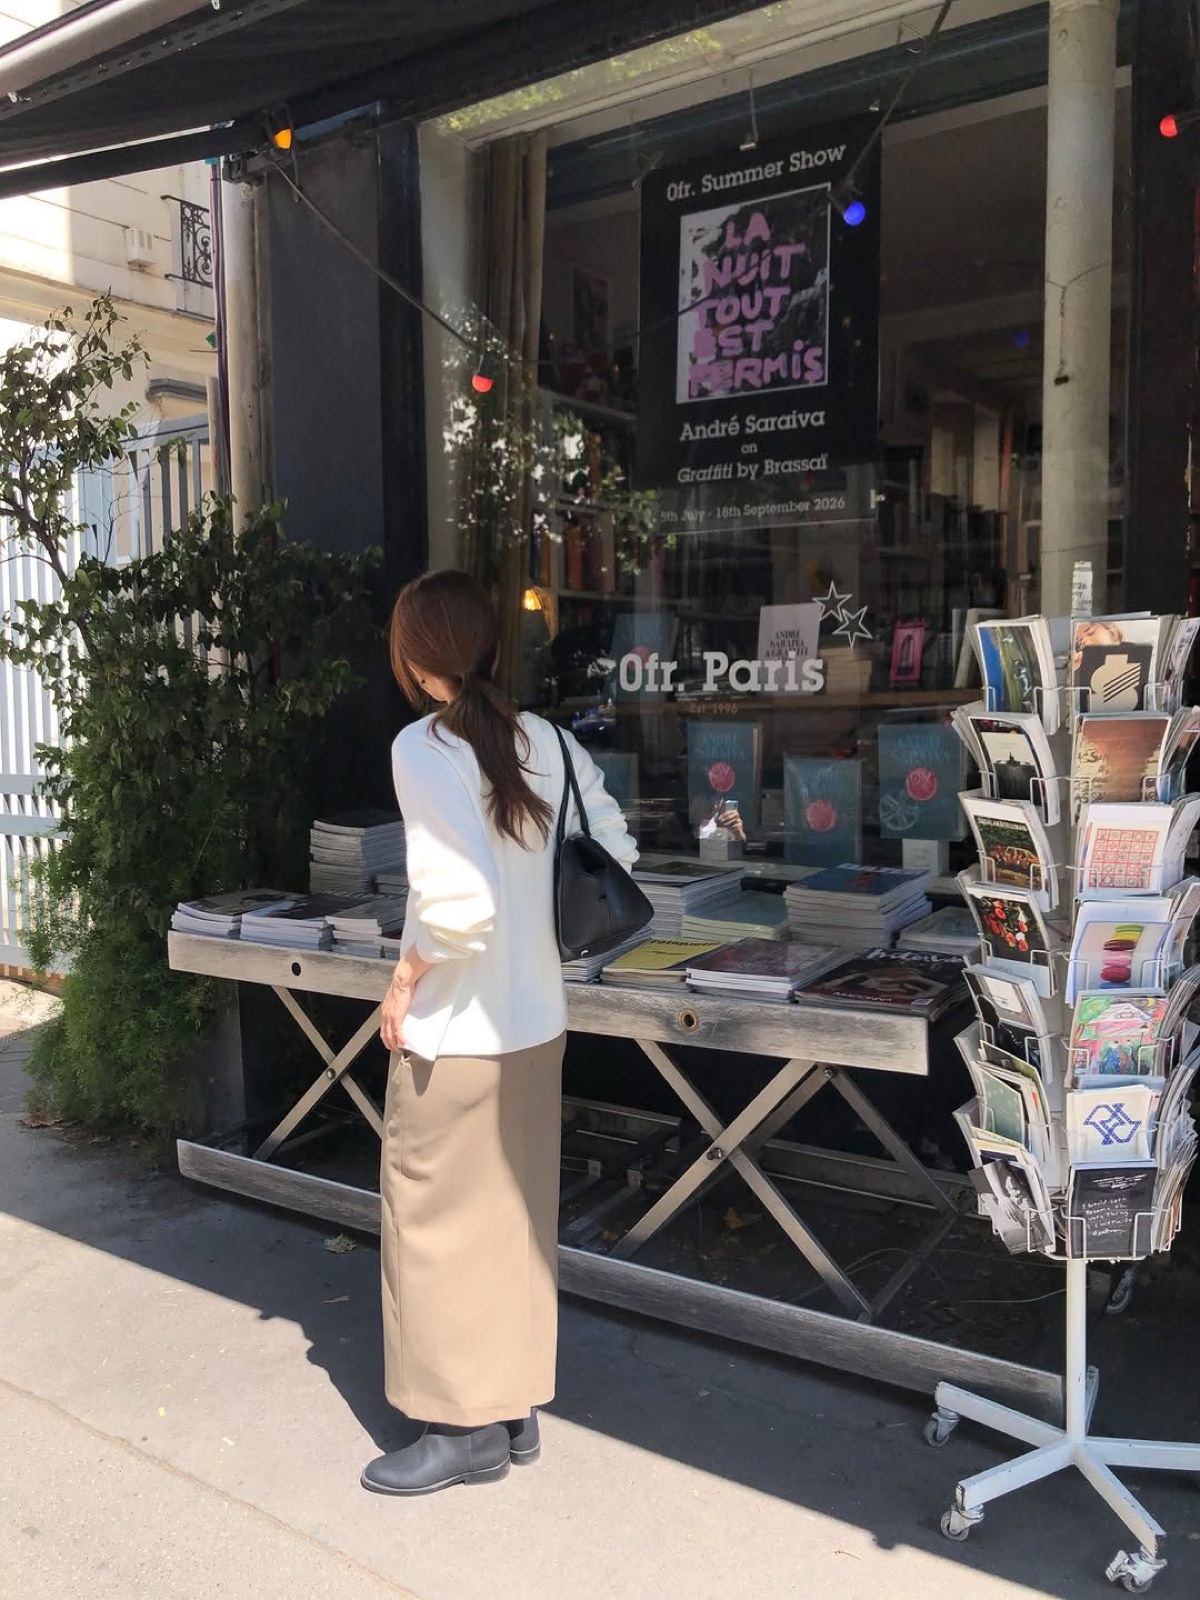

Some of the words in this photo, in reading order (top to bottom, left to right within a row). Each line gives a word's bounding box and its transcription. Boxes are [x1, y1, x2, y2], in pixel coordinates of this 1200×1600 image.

[701, 160, 784, 191] Summer
[789, 143, 848, 173] Show
[725, 212, 771, 248] LA
[700, 243, 806, 296] NUIT
[695, 286, 791, 328] TOUT
[679, 413, 741, 442] André
[745, 410, 827, 435] Saraiva
[741, 442, 758, 454] on
[677, 462, 733, 483] Graffiti
[737, 461, 760, 481] by
[764, 453, 829, 475] Brassaï
[716, 506, 741, 519] 18th
[743, 500, 811, 518] September
[813, 496, 846, 511] 2026
[702, 651, 824, 693] Paris
